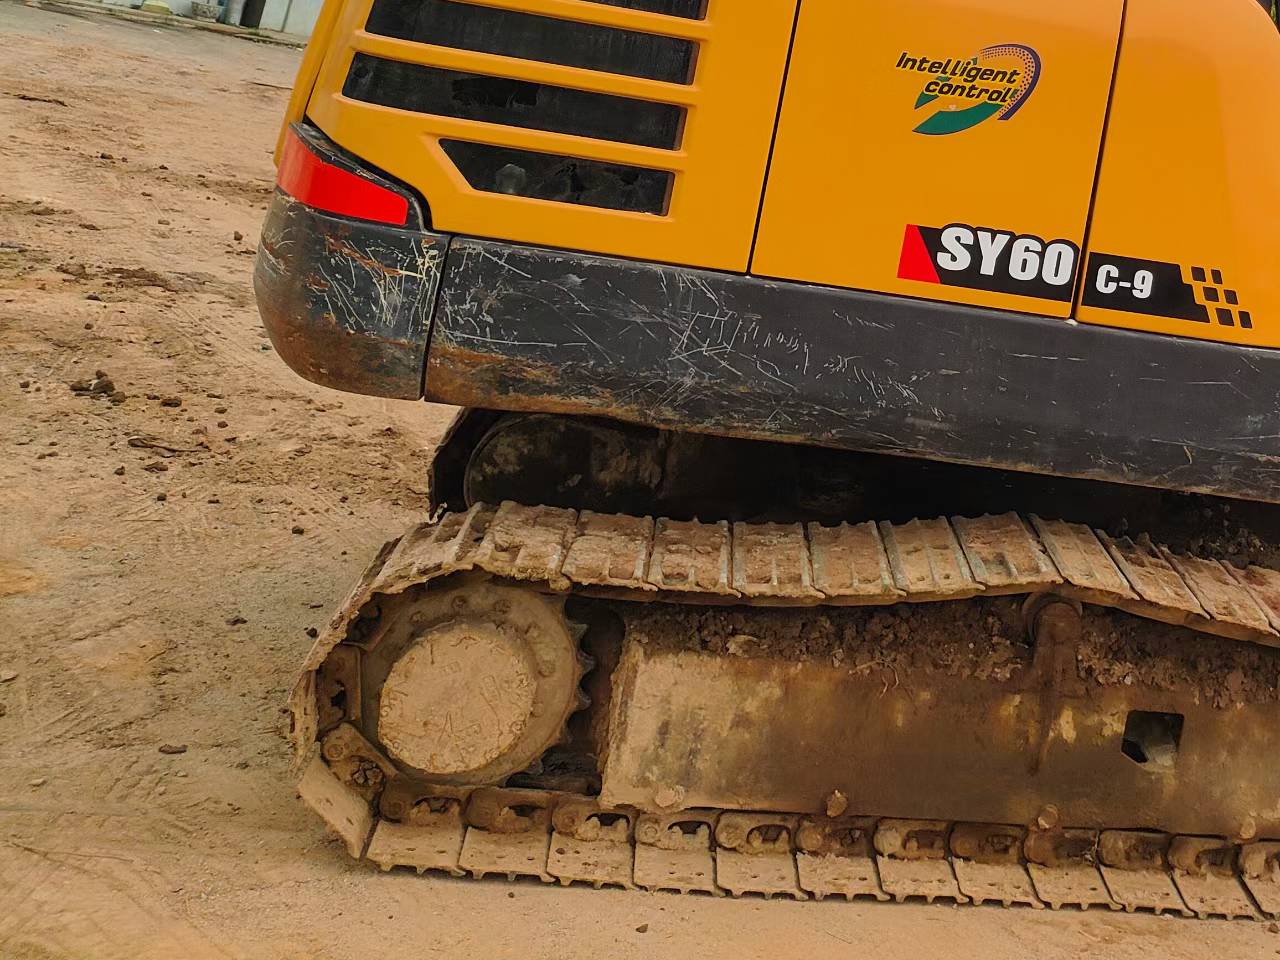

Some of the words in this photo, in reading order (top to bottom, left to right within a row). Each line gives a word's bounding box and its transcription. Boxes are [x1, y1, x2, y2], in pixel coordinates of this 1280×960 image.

[895, 52, 1021, 84] Intelligent
[924, 80, 1013, 103] control
[936, 225, 1076, 286] SY60
[1095, 264, 1154, 300] C-9
